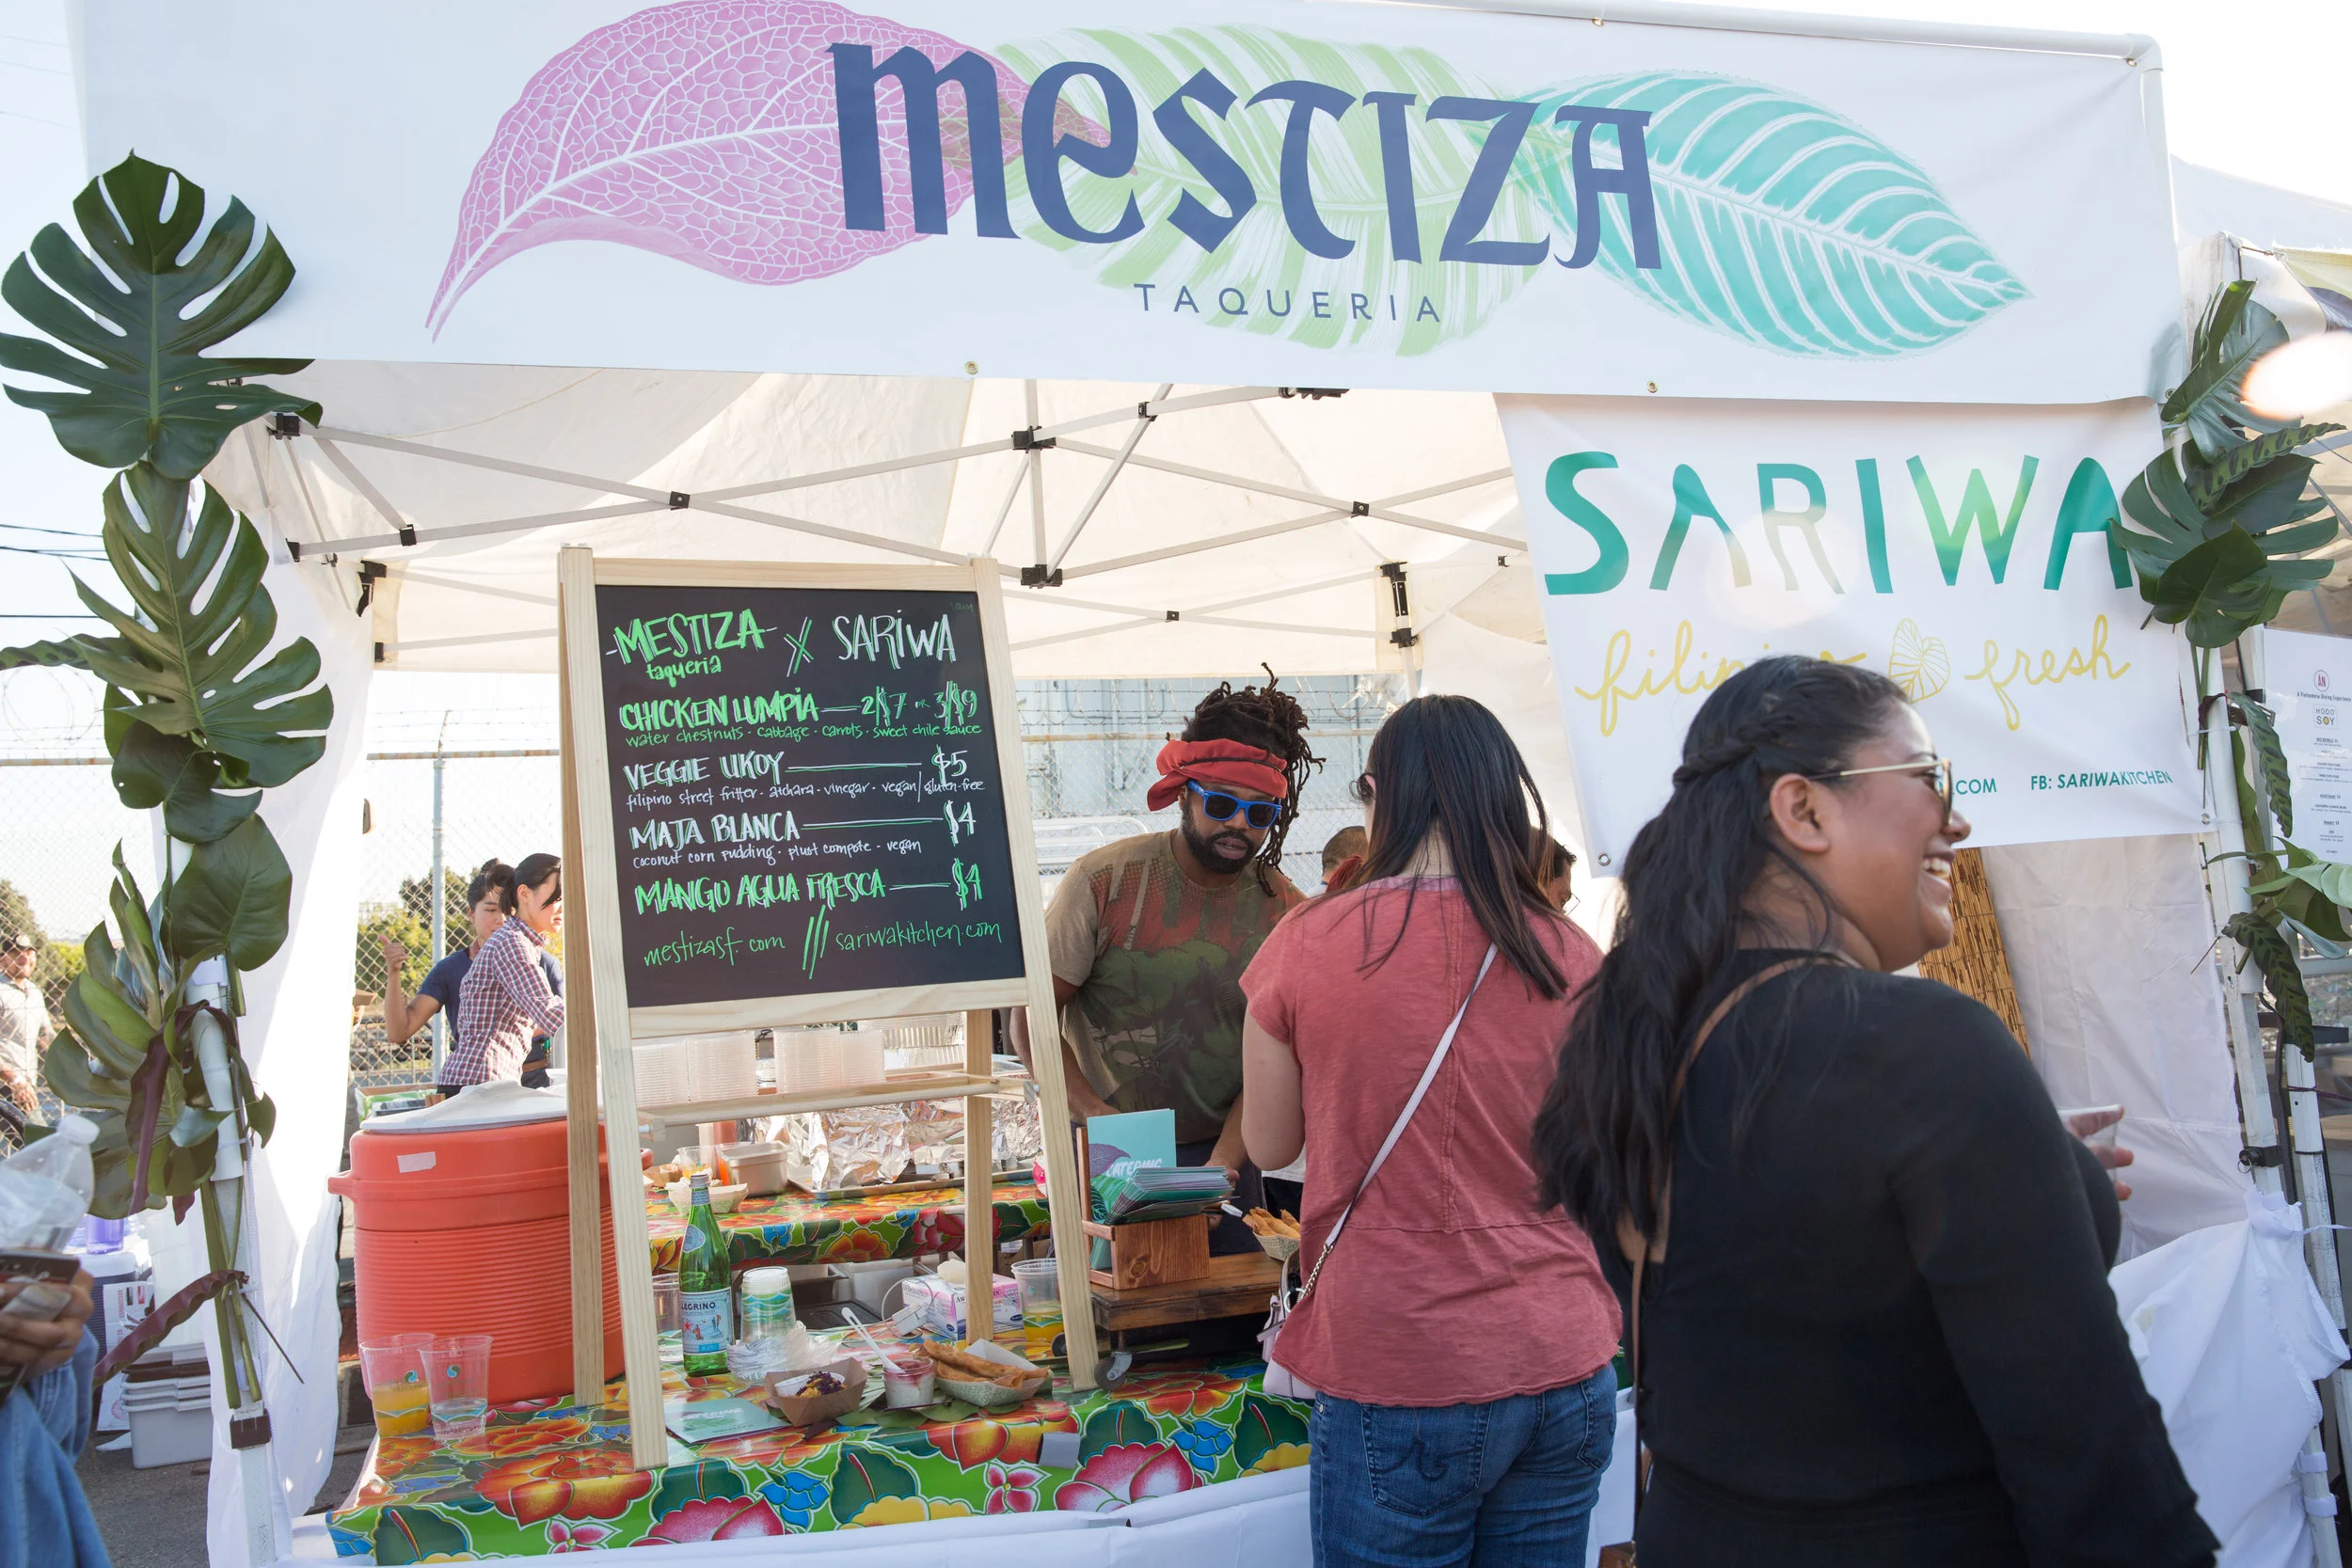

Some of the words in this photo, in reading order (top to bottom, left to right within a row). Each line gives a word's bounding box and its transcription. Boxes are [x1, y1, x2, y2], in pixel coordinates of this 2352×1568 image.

[1134, 283, 1440, 323] TAQUERIA
[1545, 451, 2135, 595] SARIWA
[613, 609, 765, 664] MESTIZA
[646, 655, 722, 688] taqueria
[1964, 613, 2132, 732] fresh
[619, 694, 729, 731] CHICKEN
[2316, 715, 2335, 726] SOY
[625, 732, 669, 748] water
[675, 727, 743, 743] chestnuts
[756, 725, 810, 742] cabbage
[822, 722, 863, 739] carrots
[873, 725, 908, 738] sweet
[912, 723, 941, 736] chile
[942, 724, 983, 736] sauce
[623, 756, 710, 792] VEGGIE
[720, 750, 786, 785] UKOY
[931, 744, 968, 786] $5
[2031, 775, 2052, 791] FB:
[2058, 769, 2173, 789] SARIWAKITCHEN
[627, 789, 672, 812] filipino
[679, 787, 715, 805] street
[720, 785, 757, 803] fritter
[770, 784, 815, 798] atchara
[824, 782, 870, 799] vinegar
[628, 817, 706, 851] MAJA
[710, 810, 800, 843] BLANCA
[943, 800, 977, 847] $4
[633, 851, 682, 869] coconut
[688, 851, 715, 863] corn
[722, 843, 776, 865] pudding
[823, 840, 872, 858] compote
[886, 839, 922, 855] vegan
[635, 877, 731, 915] MANGO
[737, 873, 800, 909] AGUA
[806, 868, 886, 911] FRESCA
[952, 858, 983, 911] $4
[835, 920, 1003, 951] sariwakitchen.com
